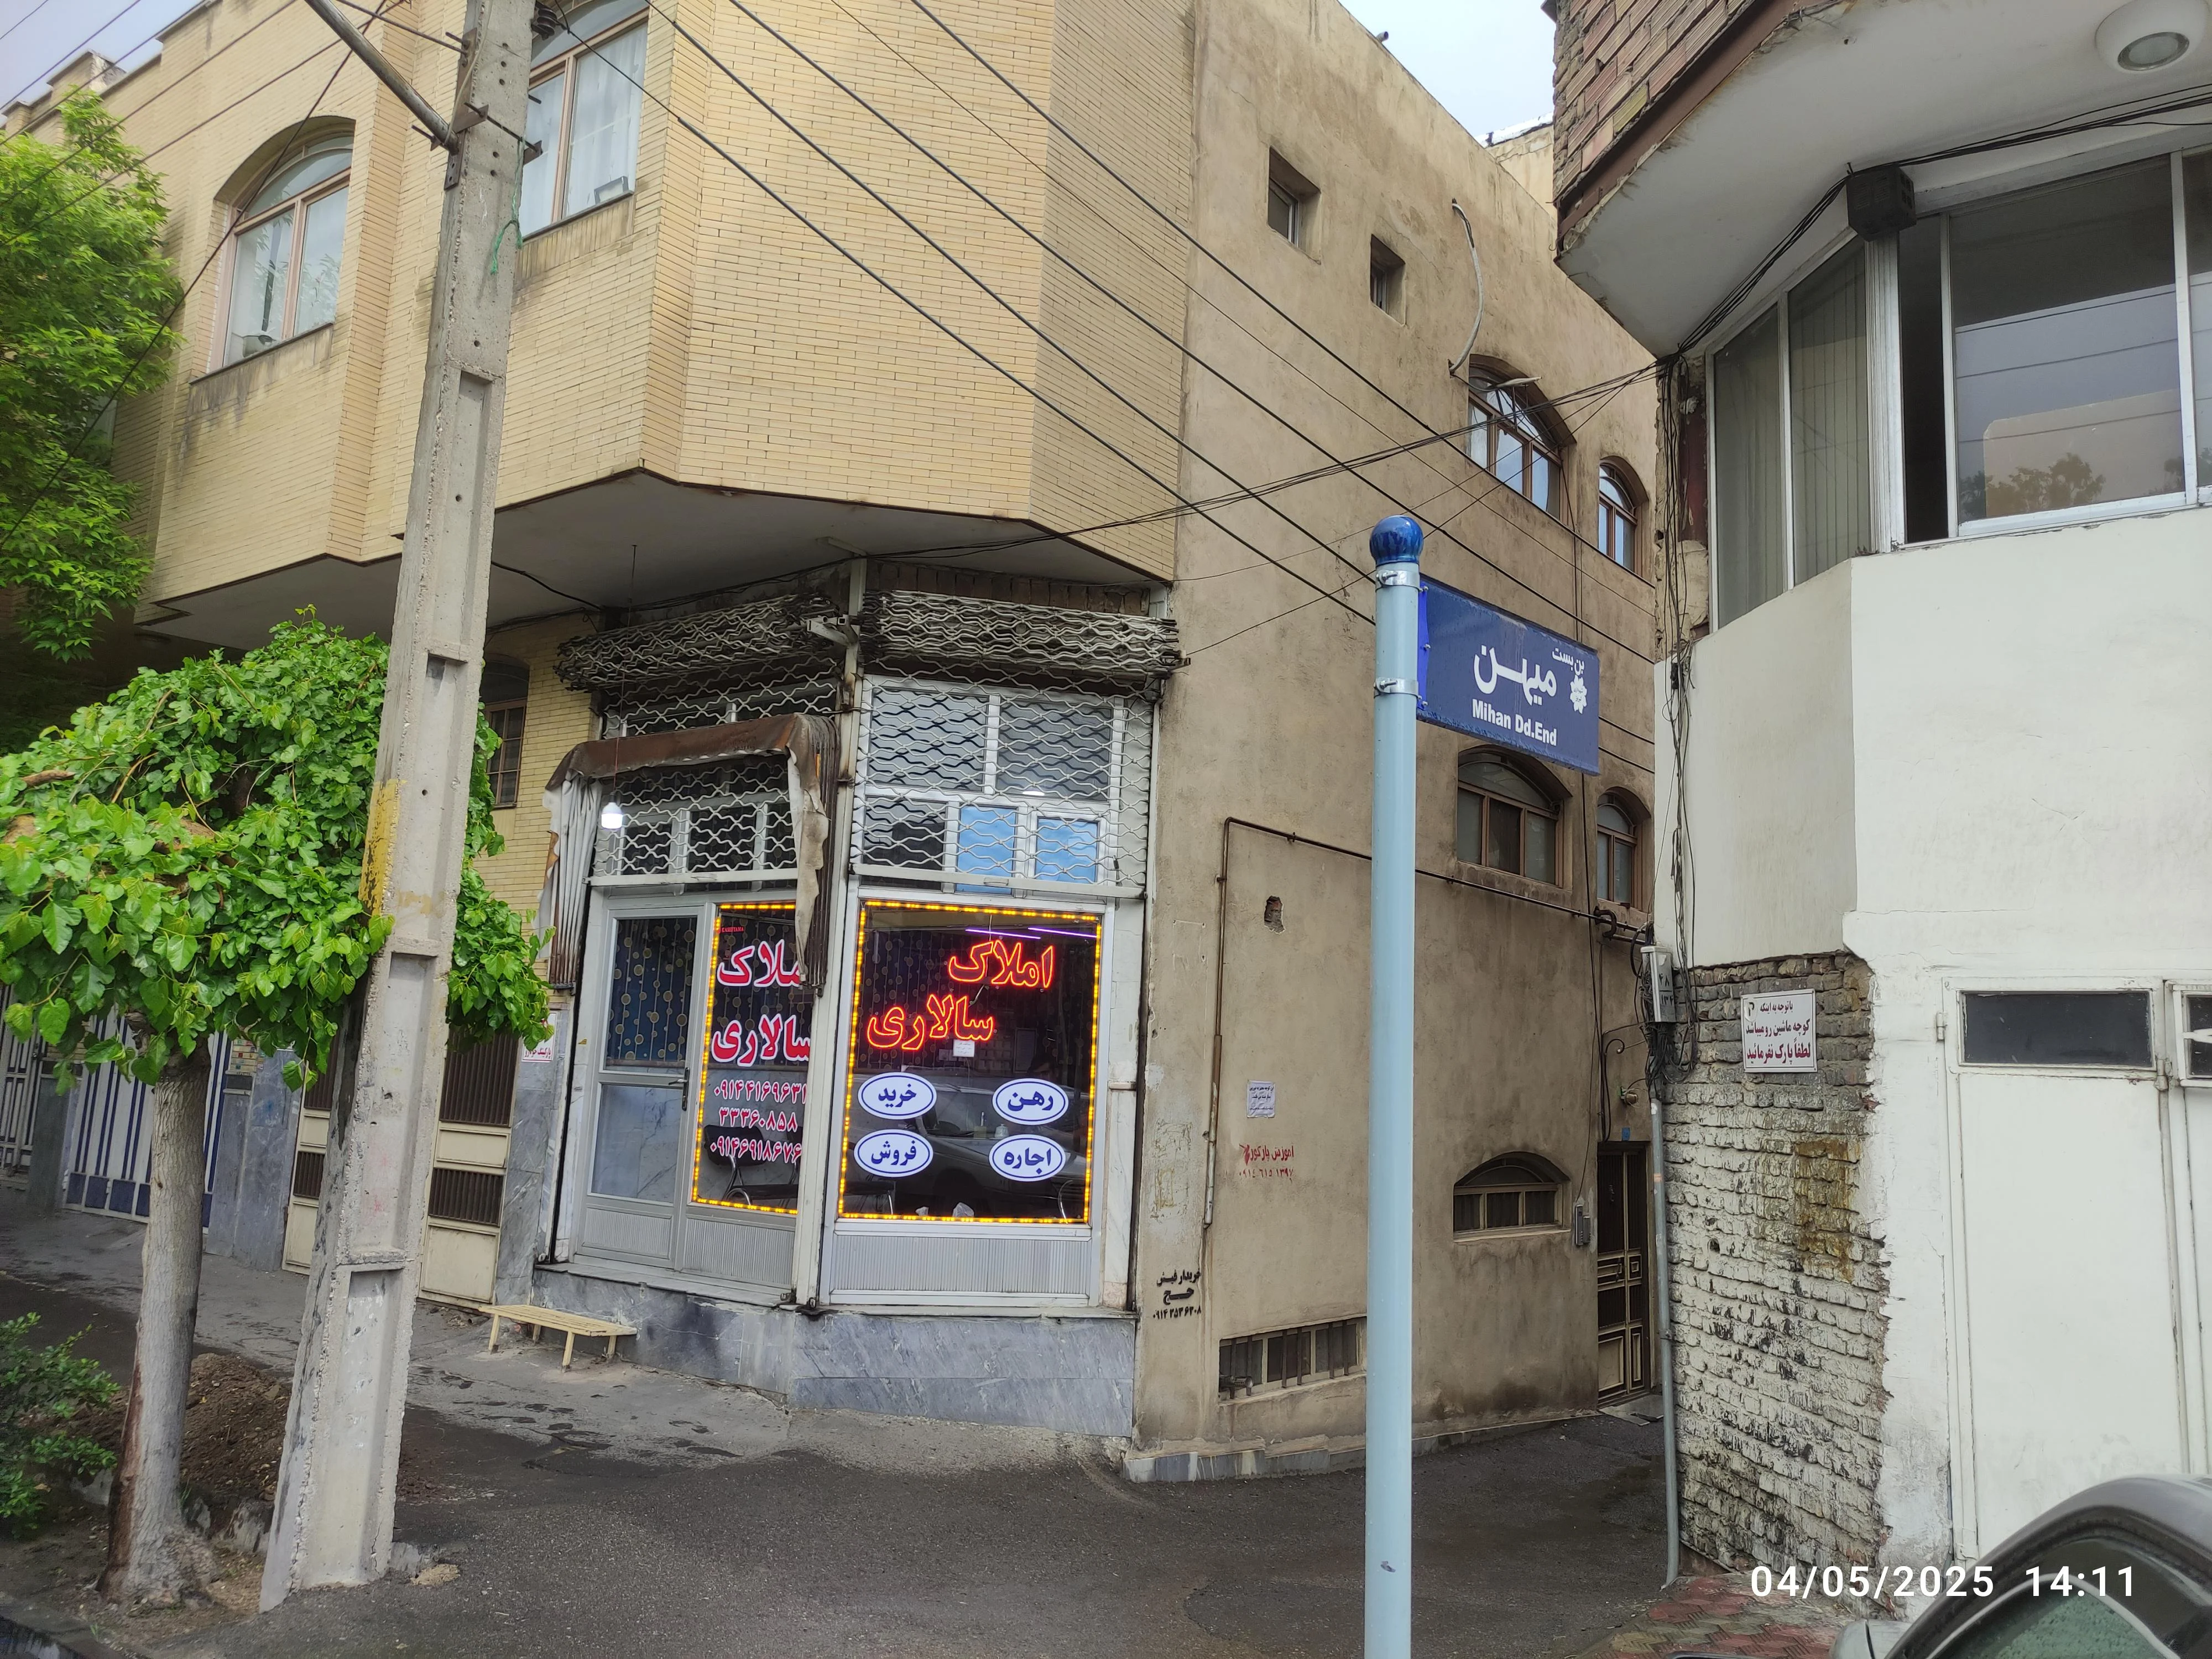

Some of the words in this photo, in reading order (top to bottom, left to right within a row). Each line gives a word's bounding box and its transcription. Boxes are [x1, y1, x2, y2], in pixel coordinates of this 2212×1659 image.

[1552, 648, 1574, 671] بست
[1574, 659, 1585, 676] بن
[1474, 645, 1557, 706] میهن
[1472, 698, 1511, 730] Mihan
[1515, 713, 1557, 747] Dd.End
[717, 939, 800, 987] ملاک
[948, 939, 1054, 989] املاک
[867, 994, 994, 1050] سالاری
[1773, 1020, 1792, 1036] ماشین
[1793, 1018, 1811, 1036] کوچه
[1775, 1043, 1793, 1065] پارک
[878, 1083, 917, 1108] خرید
[1008, 1091, 1054, 1111] رهن
[719, 1107, 798, 1132] ۳۳۳۶۰۸۵۸
[871, 1140, 917, 1166] فروش
[1004, 1148, 1052, 1175] اجاره
[1156, 1269, 1177, 1287] فیش
[1163, 1287, 1194, 1306] حج
